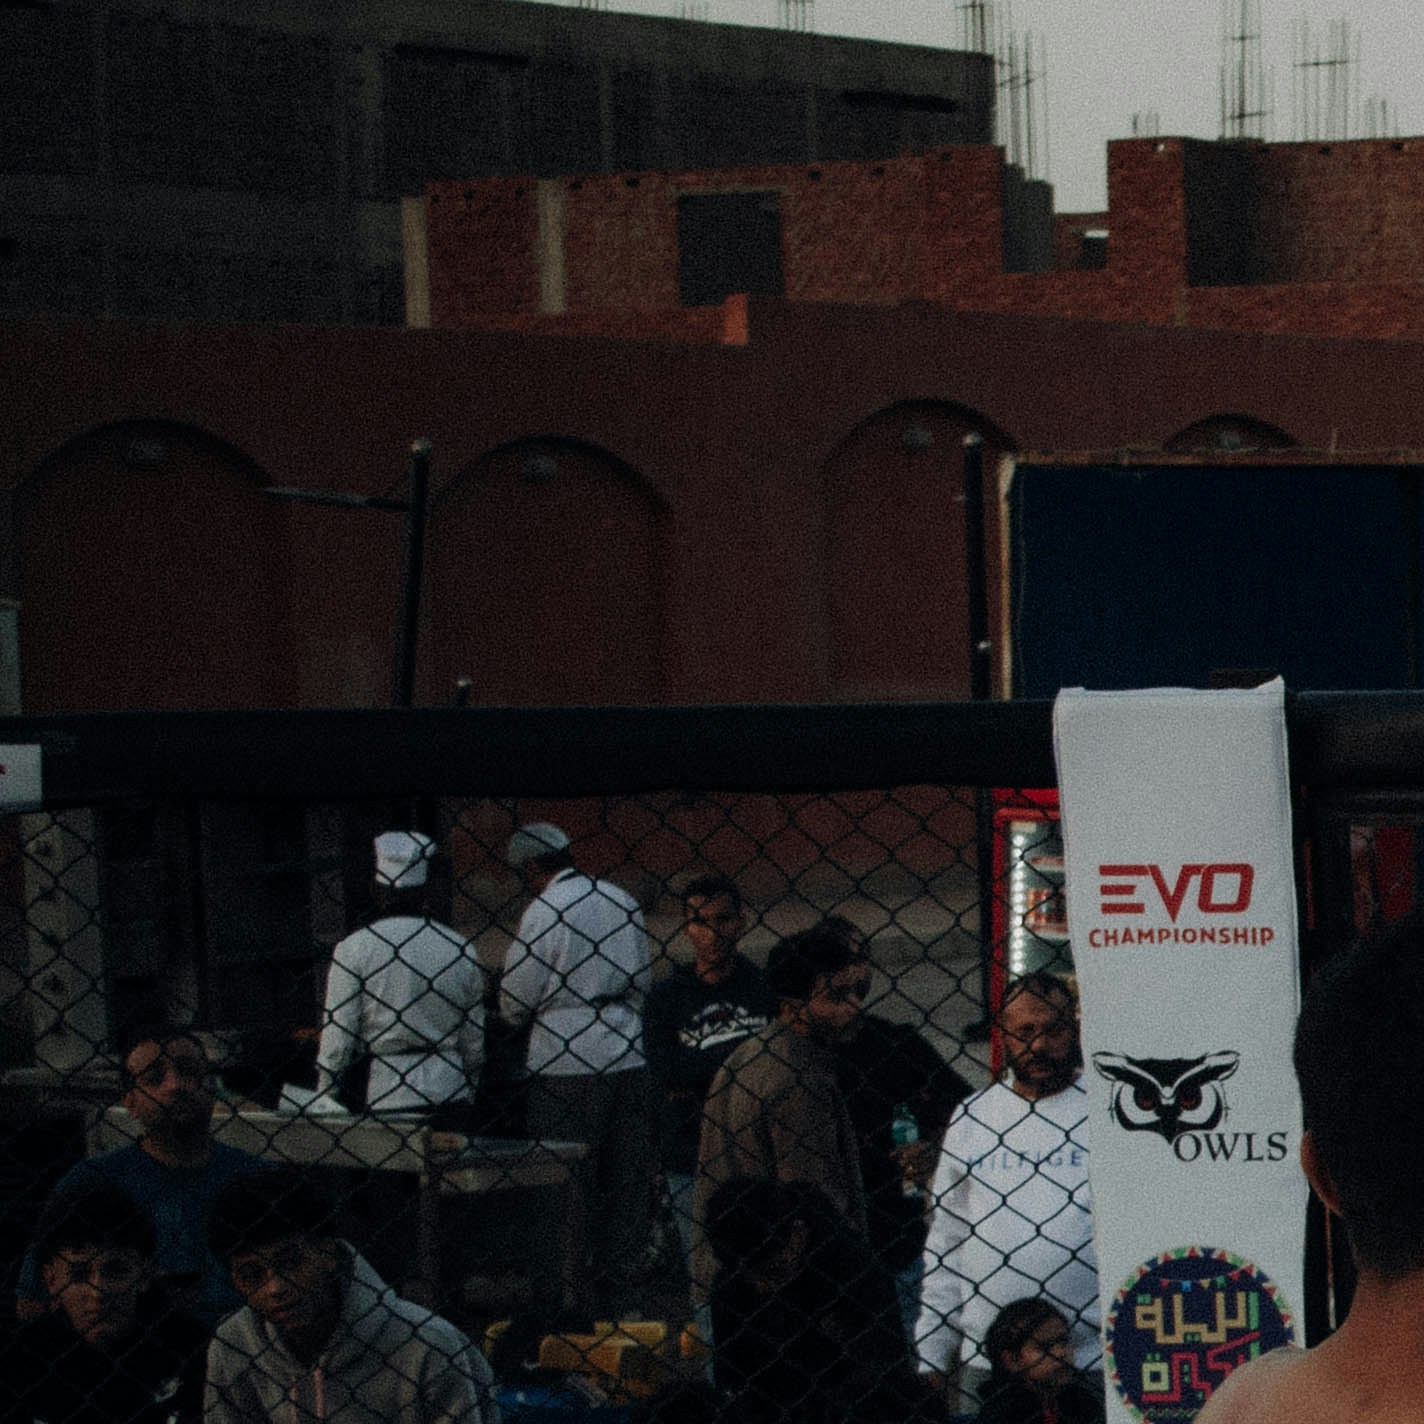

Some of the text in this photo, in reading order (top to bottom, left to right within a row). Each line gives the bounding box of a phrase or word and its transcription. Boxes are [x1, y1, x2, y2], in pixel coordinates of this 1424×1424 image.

[1099, 864, 1254, 924] EVO
[1089, 927, 1275, 948] CHAMPIONSHIP
[1173, 1132, 1288, 1163] OWLS
